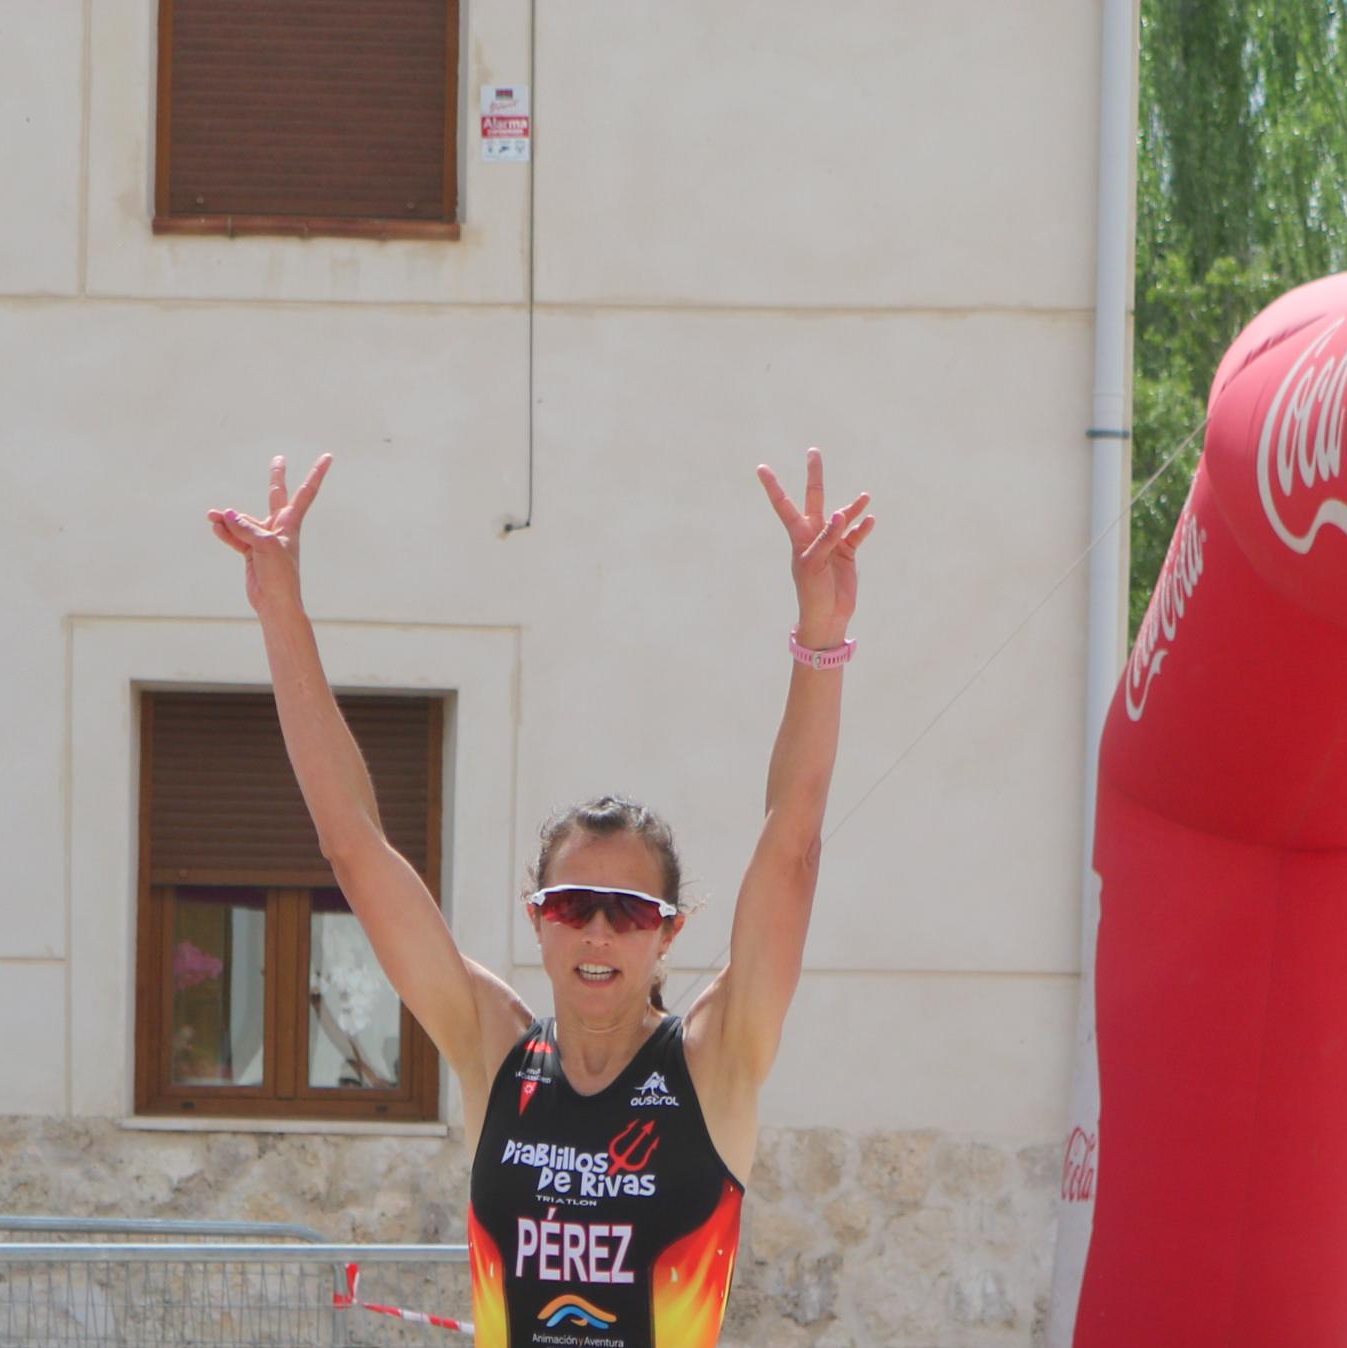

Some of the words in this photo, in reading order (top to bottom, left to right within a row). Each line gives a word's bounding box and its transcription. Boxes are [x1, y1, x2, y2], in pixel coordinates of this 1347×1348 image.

[537, 1166, 572, 1193] De
[580, 1172, 656, 1198] Rivas
[535, 1194, 598, 1206] TRIATLON
[515, 1207, 635, 1283] PÉREZ
